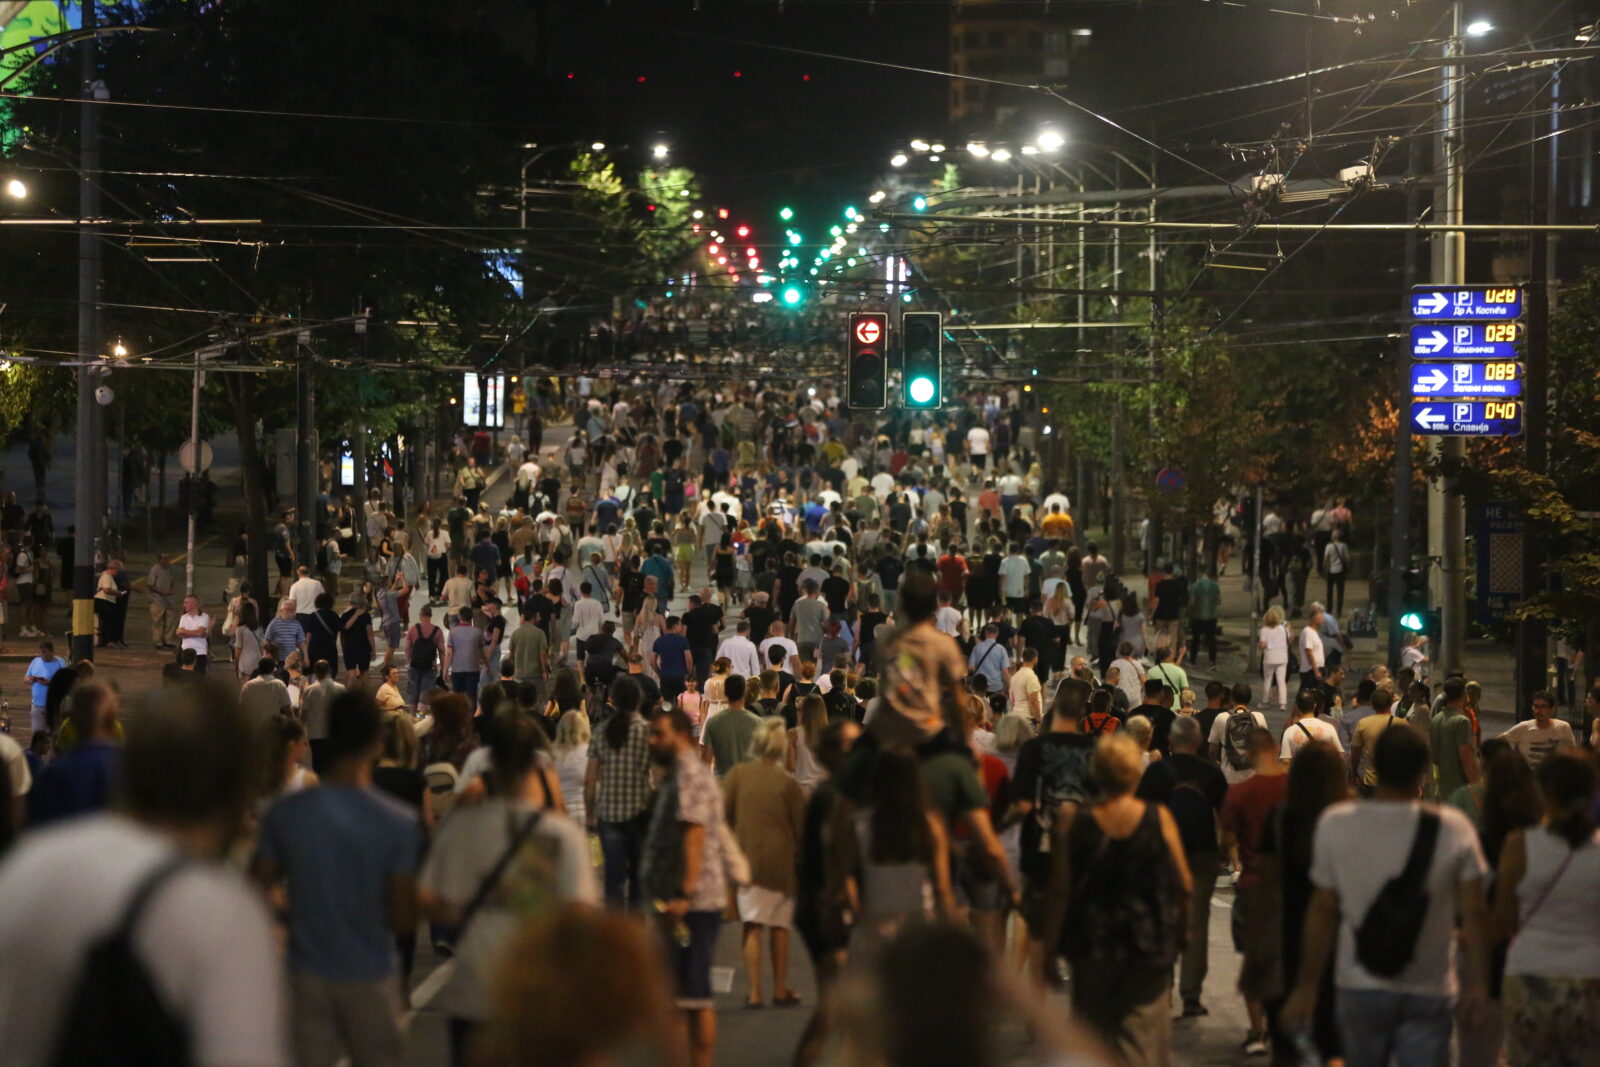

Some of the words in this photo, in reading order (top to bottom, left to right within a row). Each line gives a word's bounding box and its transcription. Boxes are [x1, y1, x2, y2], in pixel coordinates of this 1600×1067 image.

[1458, 291, 1469, 305] P
[1453, 306, 1465, 316] Др
[1475, 306, 1507, 315] Костића
[1457, 328, 1469, 343] P
[1485, 325, 1516, 342] 029
[1457, 366, 1469, 382] P
[1485, 363, 1516, 380] 089
[1456, 405, 1469, 420] P
[1485, 403, 1516, 419] 040
[1453, 422, 1489, 433] Славија
